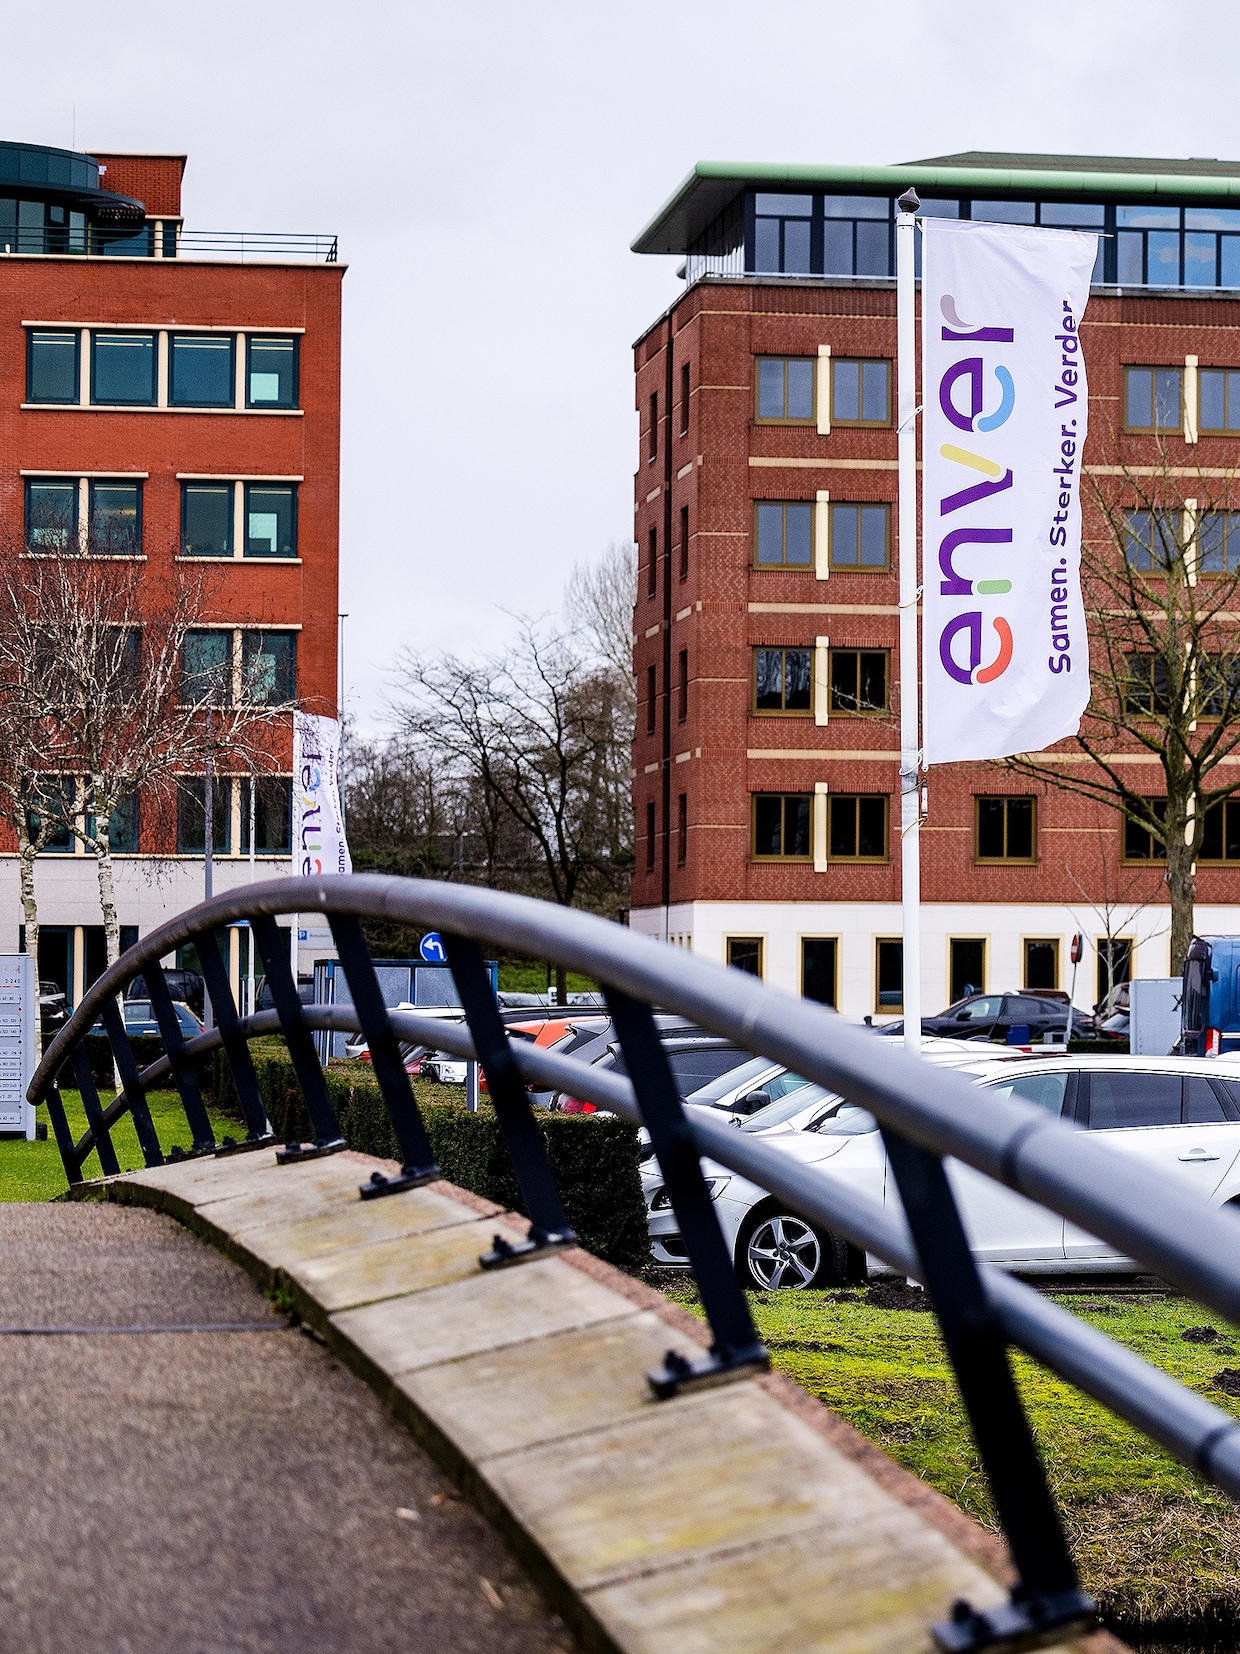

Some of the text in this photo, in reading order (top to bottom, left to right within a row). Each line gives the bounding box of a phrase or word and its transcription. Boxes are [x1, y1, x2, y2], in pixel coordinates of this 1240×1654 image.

[939, 293, 1016, 686] enver
[1049, 419, 1079, 547] Sterker.
[1047, 557, 1071, 675] Samen.
